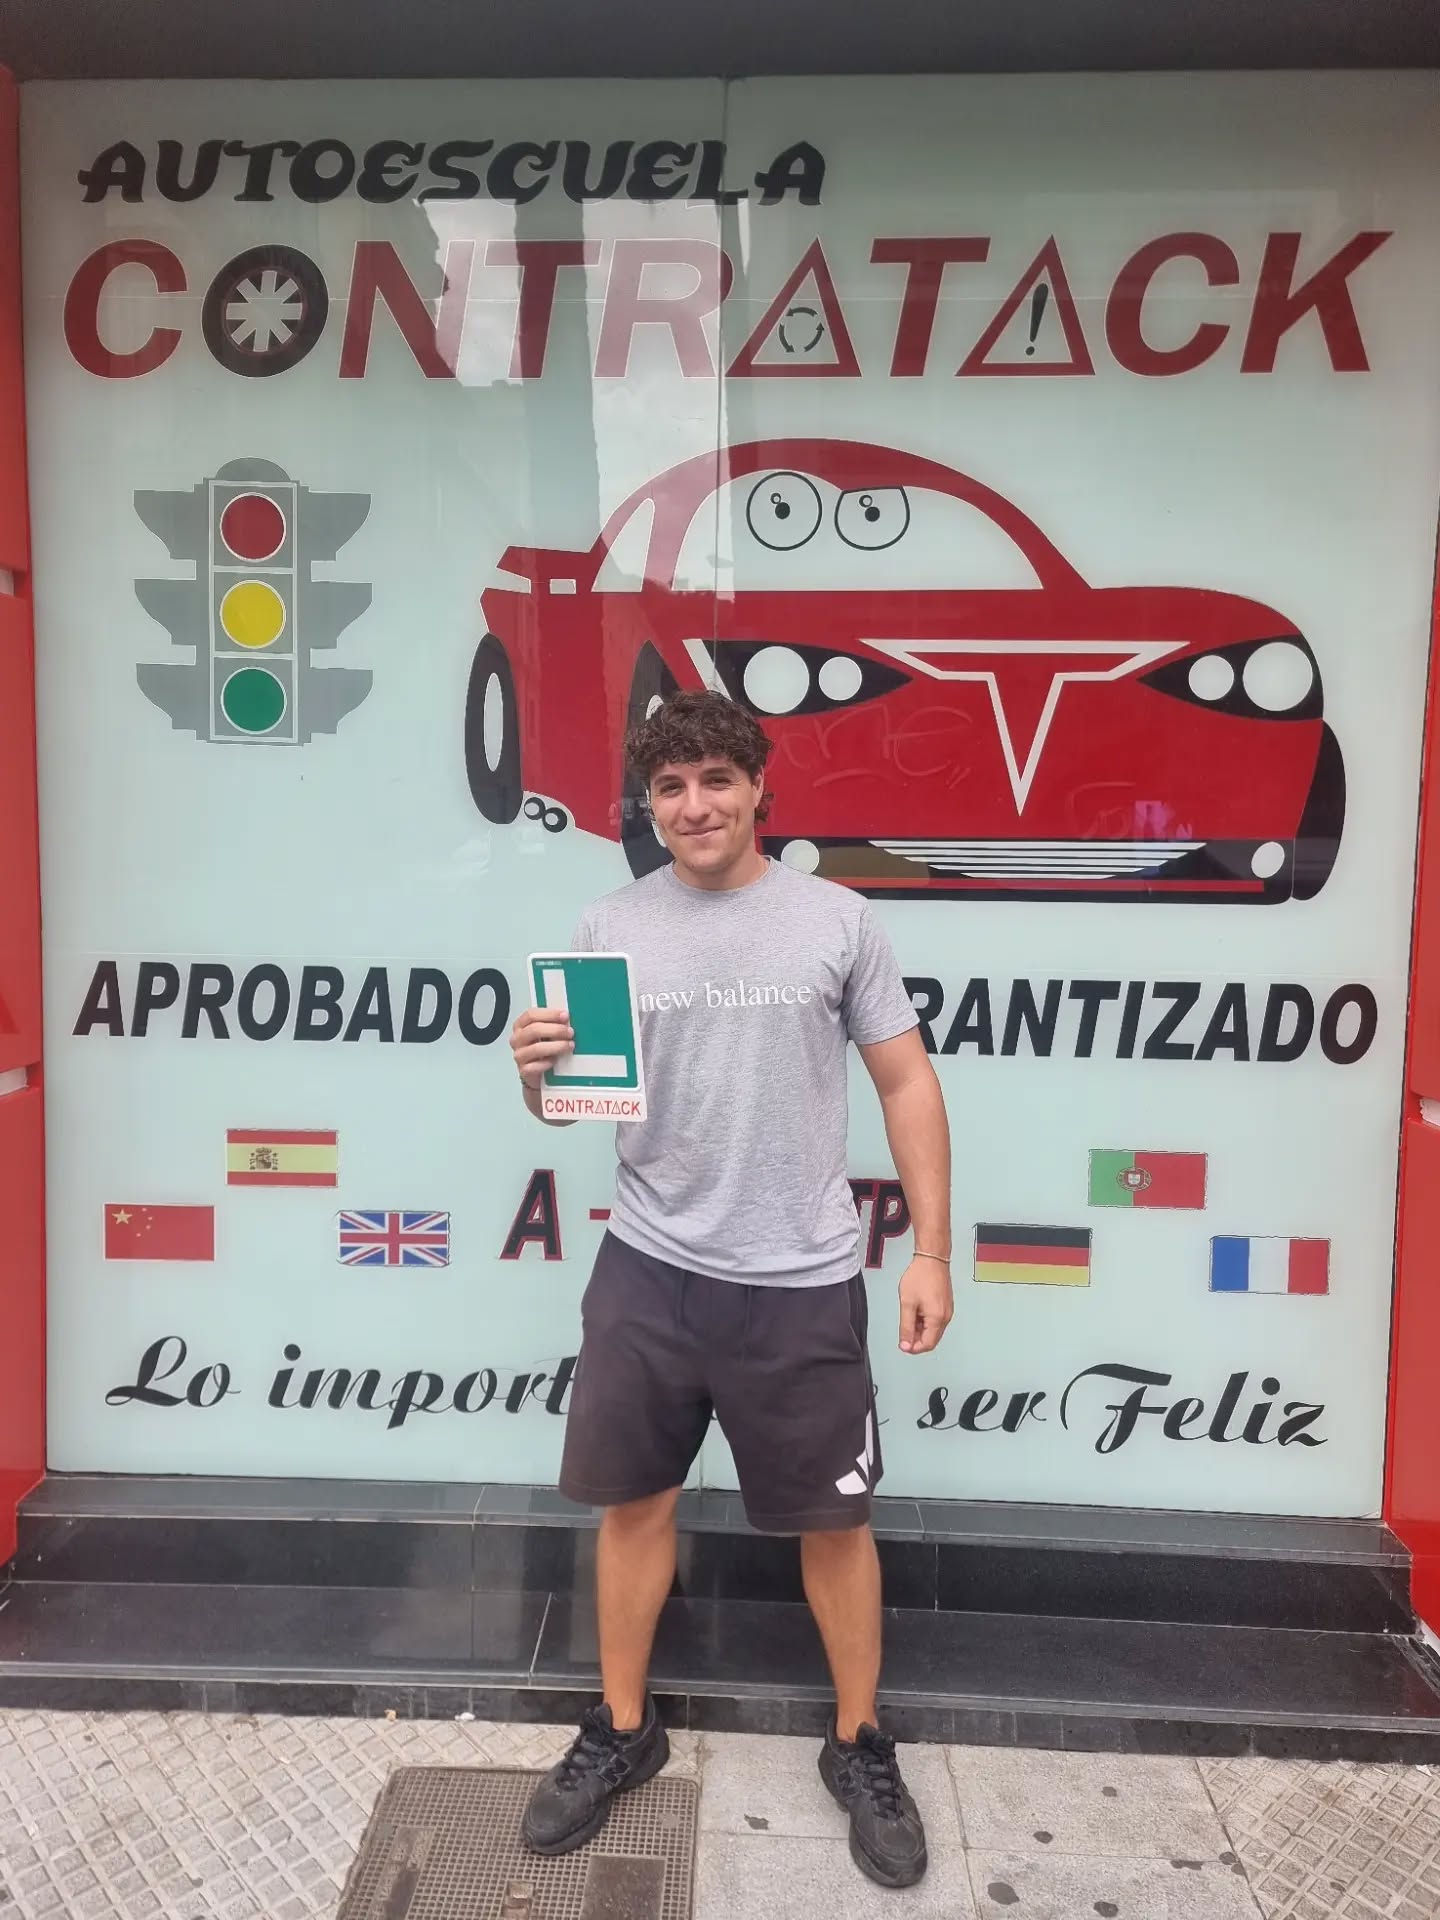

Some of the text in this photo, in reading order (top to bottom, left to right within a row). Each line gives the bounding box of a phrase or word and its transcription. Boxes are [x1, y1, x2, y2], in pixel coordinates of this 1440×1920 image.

[78, 138, 826, 207] AUTOESCUELA
[63, 231, 1395, 379] CONTRATACK
[72, 960, 511, 1046] APROBADO
[639, 979, 812, 1012] new balance
[544, 1098, 642, 1116] CONTRATACK
[499, 1168, 563, 1261] A
[846, 1178, 912, 1269] P
[104, 1336, 242, 1407] Lo
[916, 1386, 1047, 1434] ser
[1060, 1363, 1329, 1455] Feliz
